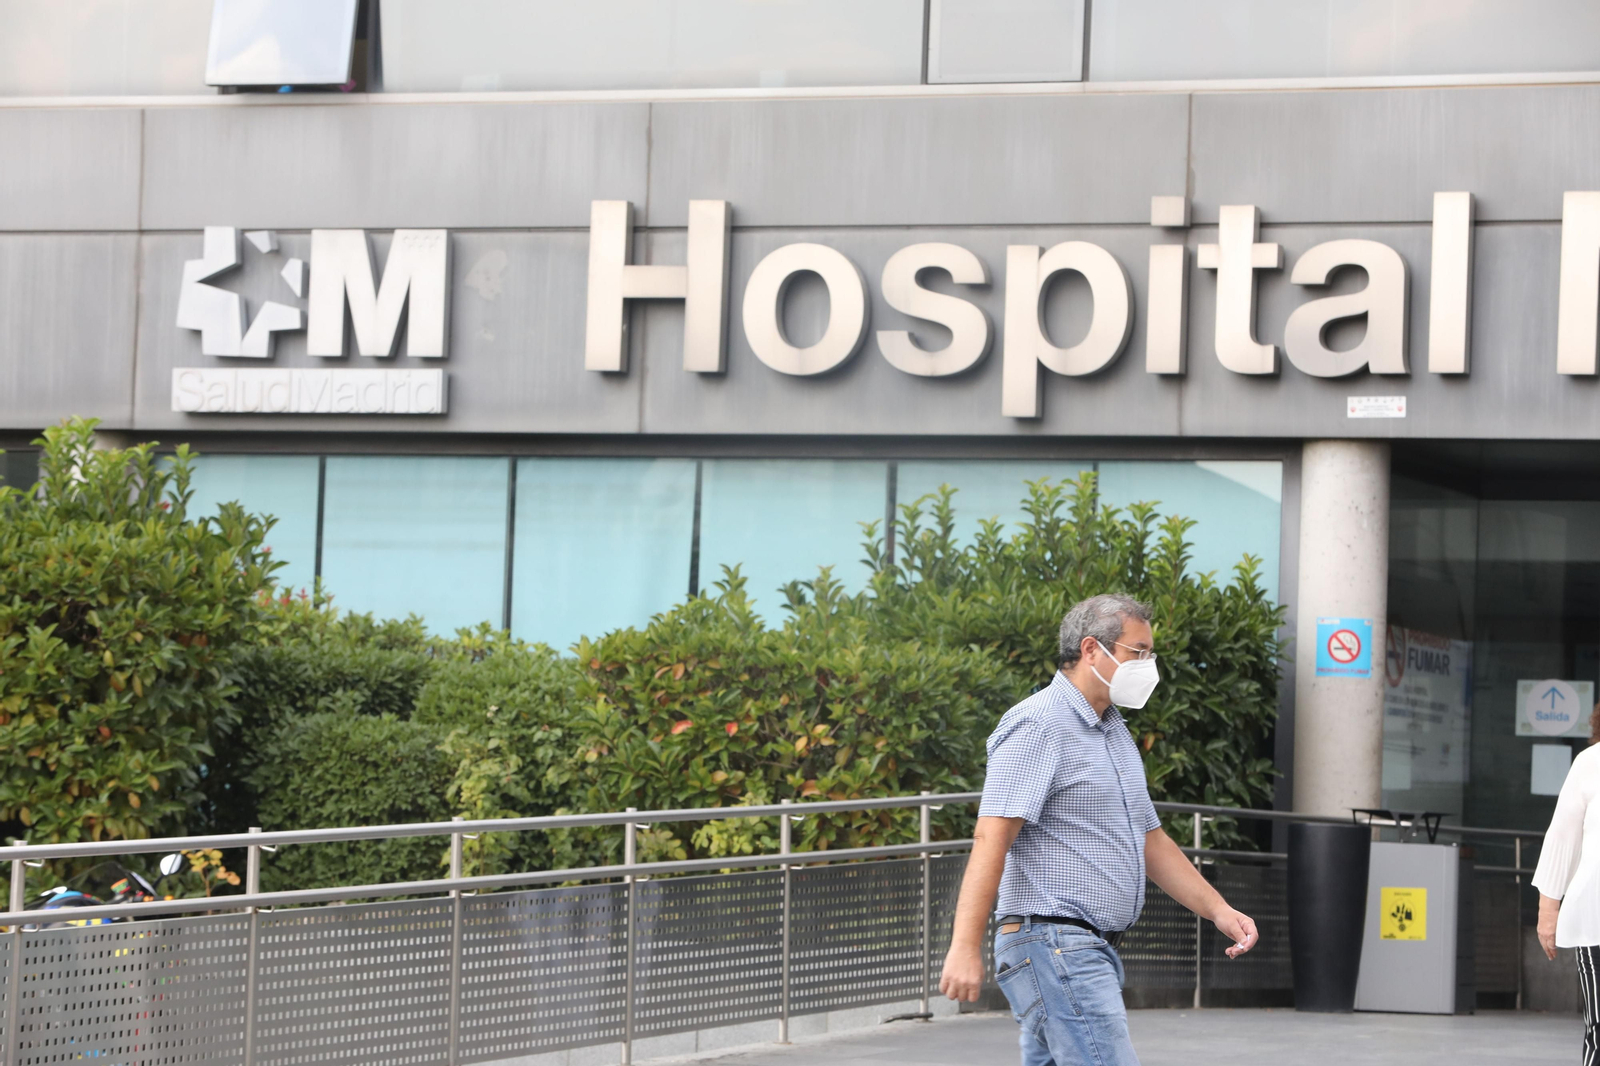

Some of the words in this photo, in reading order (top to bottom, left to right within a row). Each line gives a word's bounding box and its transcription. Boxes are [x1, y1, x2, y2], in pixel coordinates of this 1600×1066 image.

[306, 228, 450, 358] M
[584, 190, 1474, 420] Hospital
[1407, 646, 1451, 677] FUMAR
[1535, 710, 1570, 723] Salida
